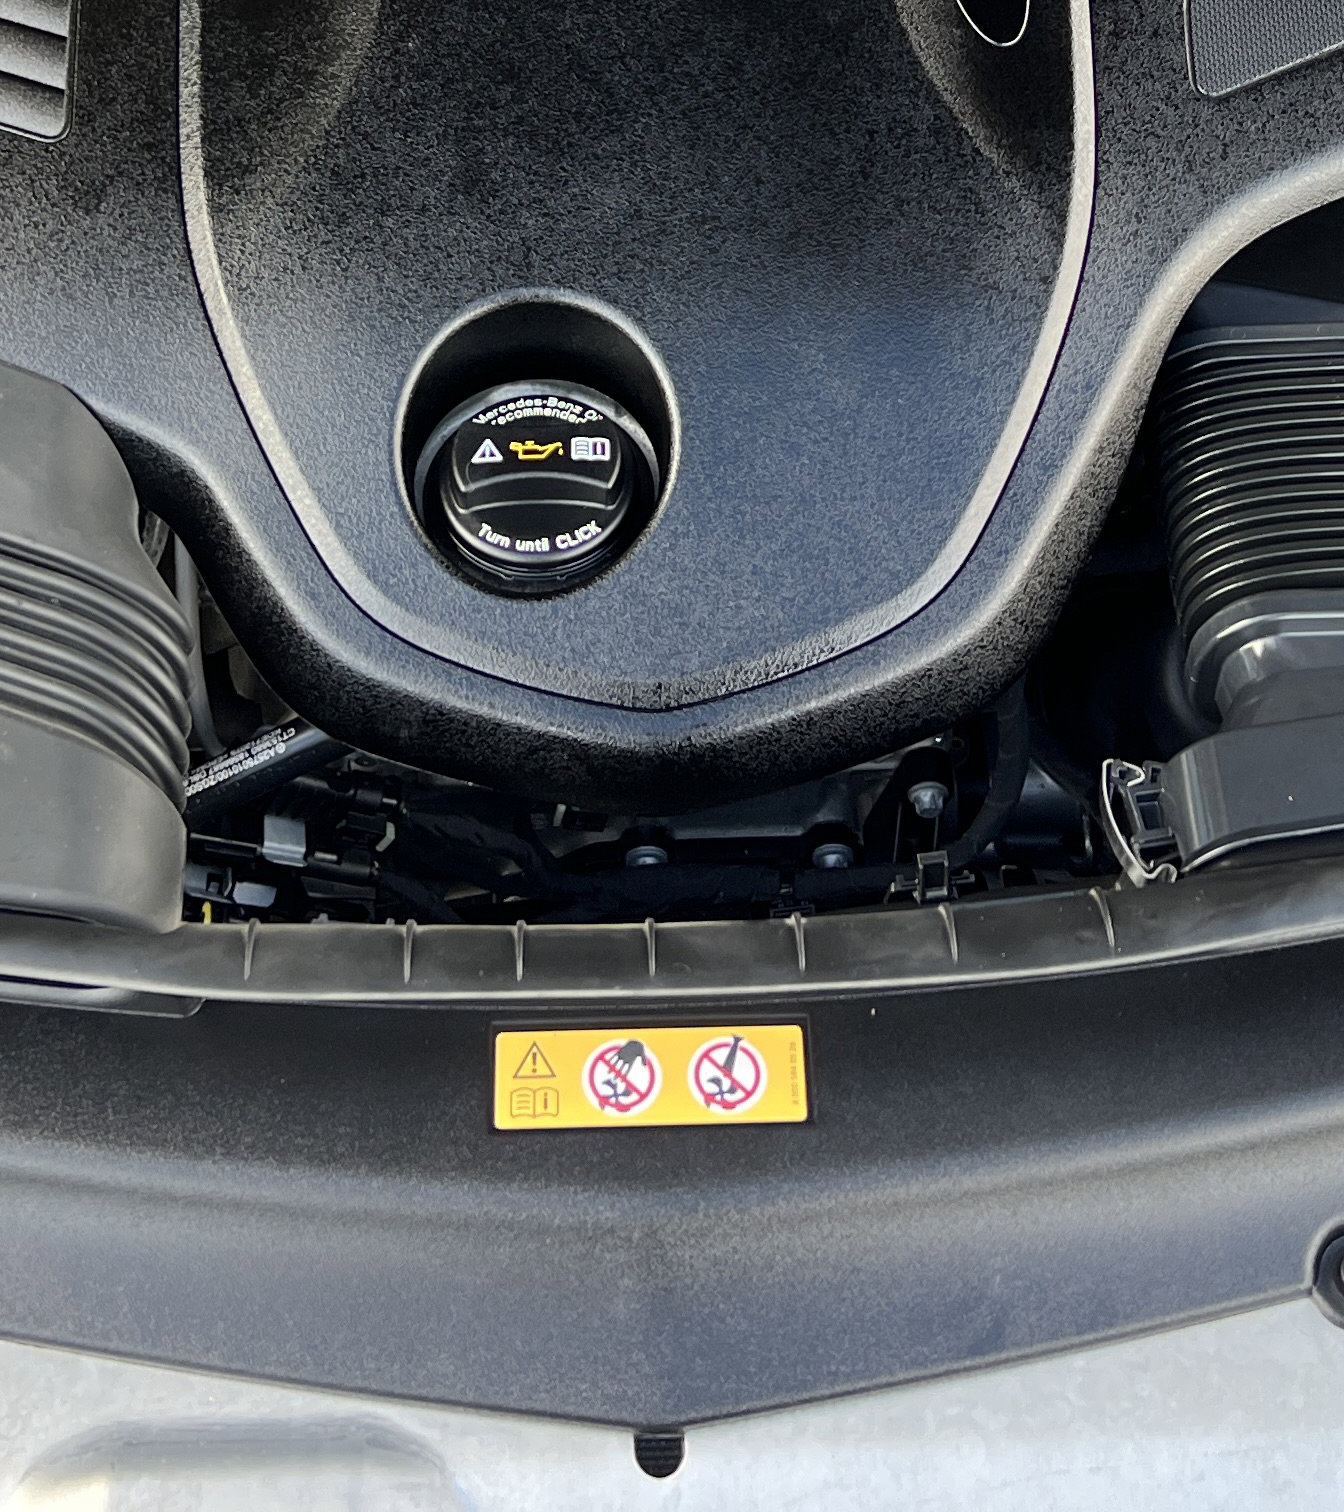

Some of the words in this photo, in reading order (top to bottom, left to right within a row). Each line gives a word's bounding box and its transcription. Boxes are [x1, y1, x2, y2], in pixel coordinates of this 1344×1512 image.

[472, 396, 583, 425] Mercedes-Benz
[477, 522, 510, 551] Turn
[515, 536, 550, 553] until
[556, 520, 602, 550] CLICK
